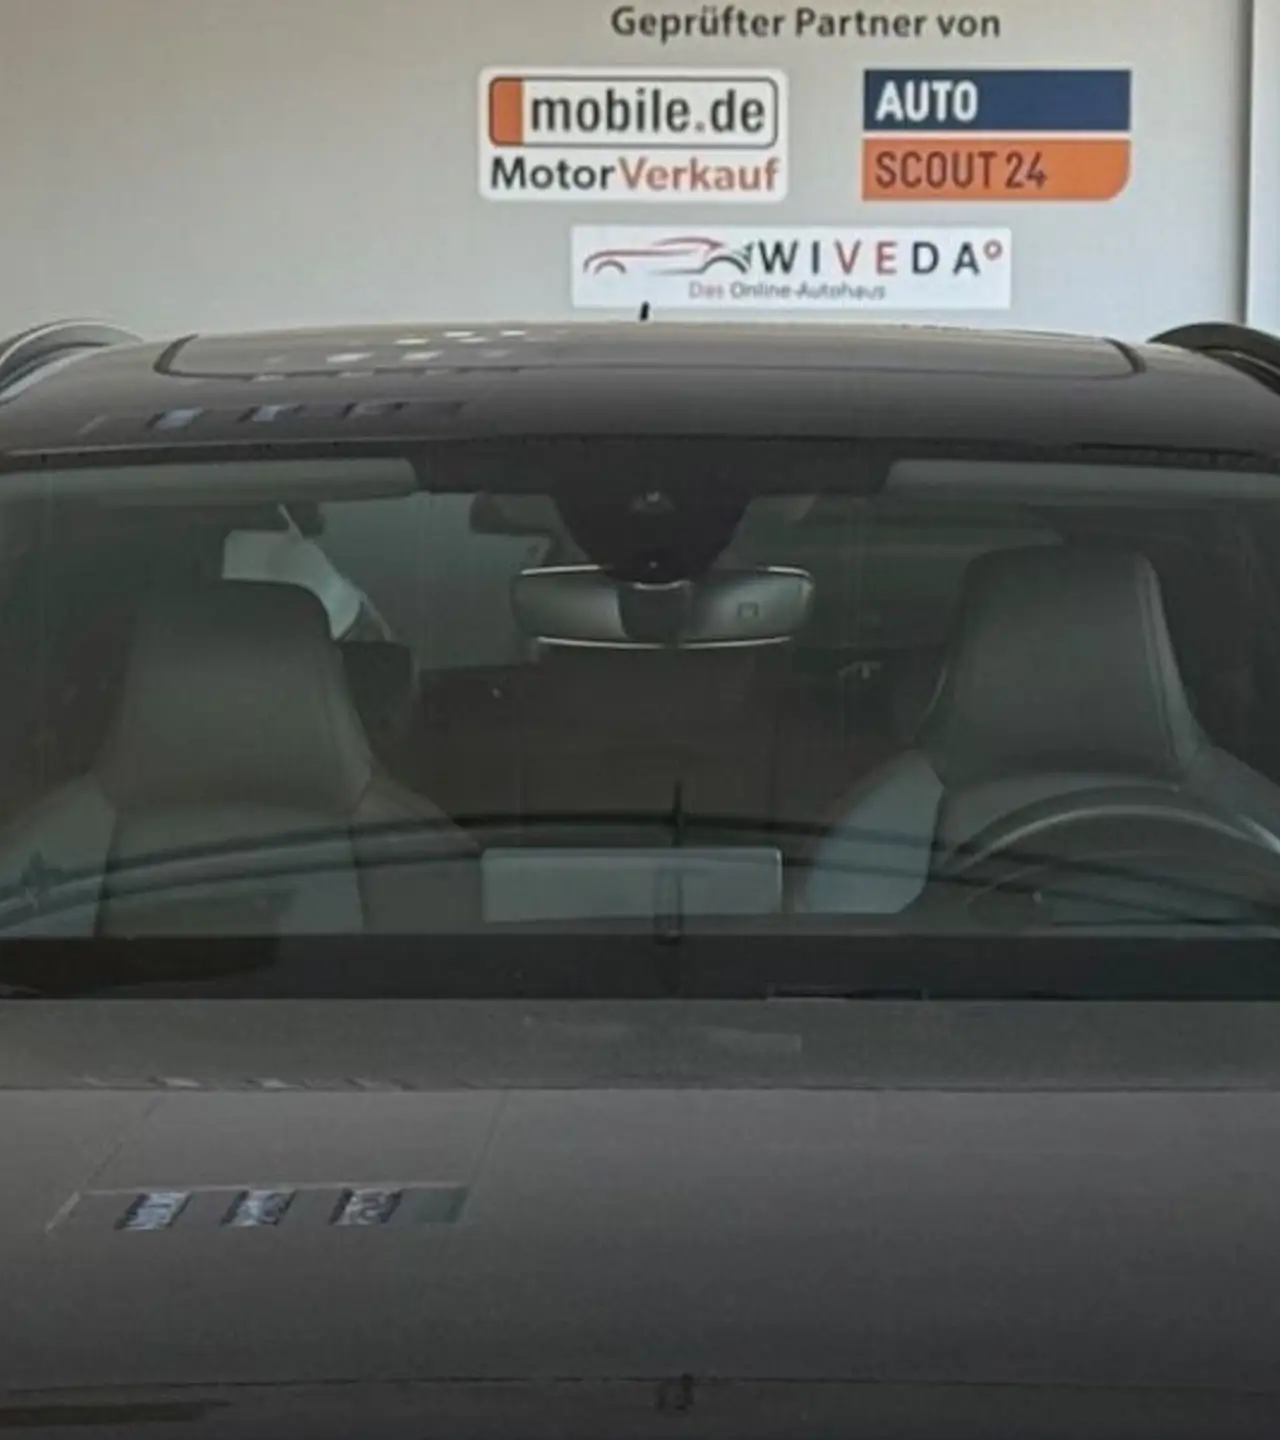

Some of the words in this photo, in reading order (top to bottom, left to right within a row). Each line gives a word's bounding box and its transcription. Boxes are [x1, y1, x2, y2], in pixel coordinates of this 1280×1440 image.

[611, 6, 784, 44] Geprüfter
[794, 7, 928, 37] Partner
[937, 13, 1001, 37] von
[530, 87, 766, 134] mobile.de
[876, 82, 978, 121] AUTO
[876, 152, 998, 189] SCOUT
